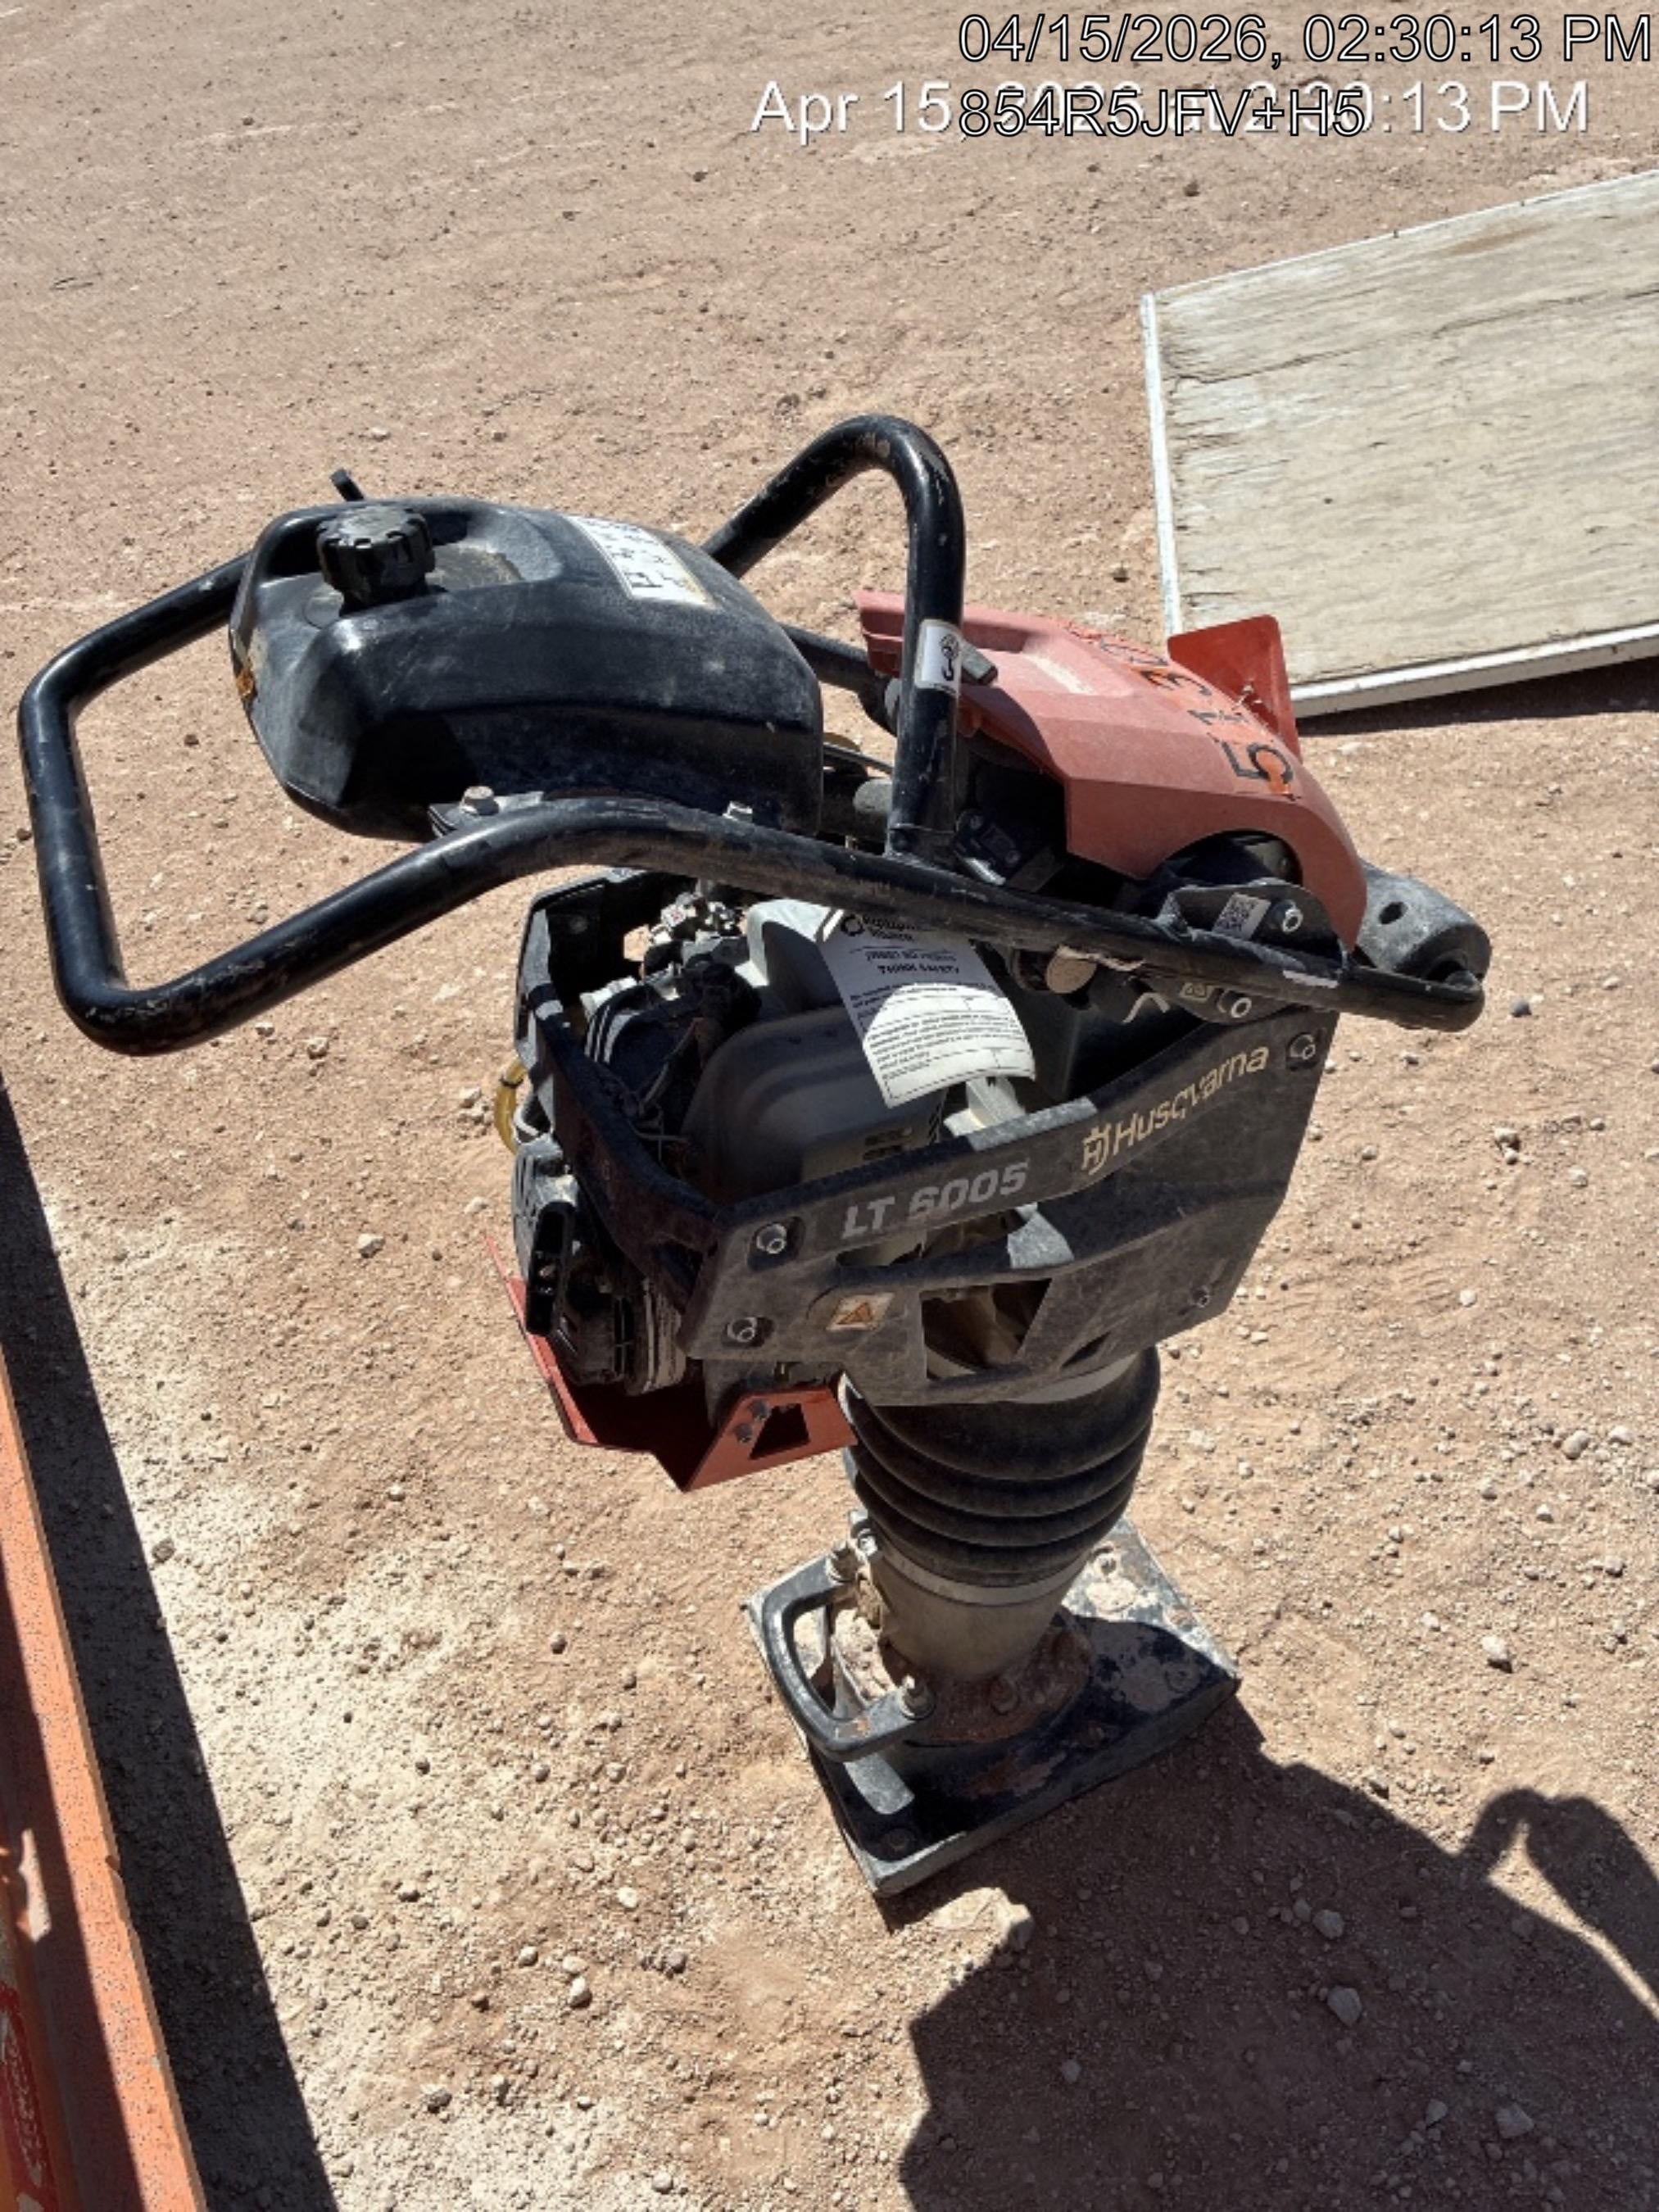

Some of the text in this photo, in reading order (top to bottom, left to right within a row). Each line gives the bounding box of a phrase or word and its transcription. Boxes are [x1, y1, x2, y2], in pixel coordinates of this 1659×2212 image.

[1113, 1045, 1270, 1156] Husqvarna
[841, 1158, 1030, 1240] LT 6005
